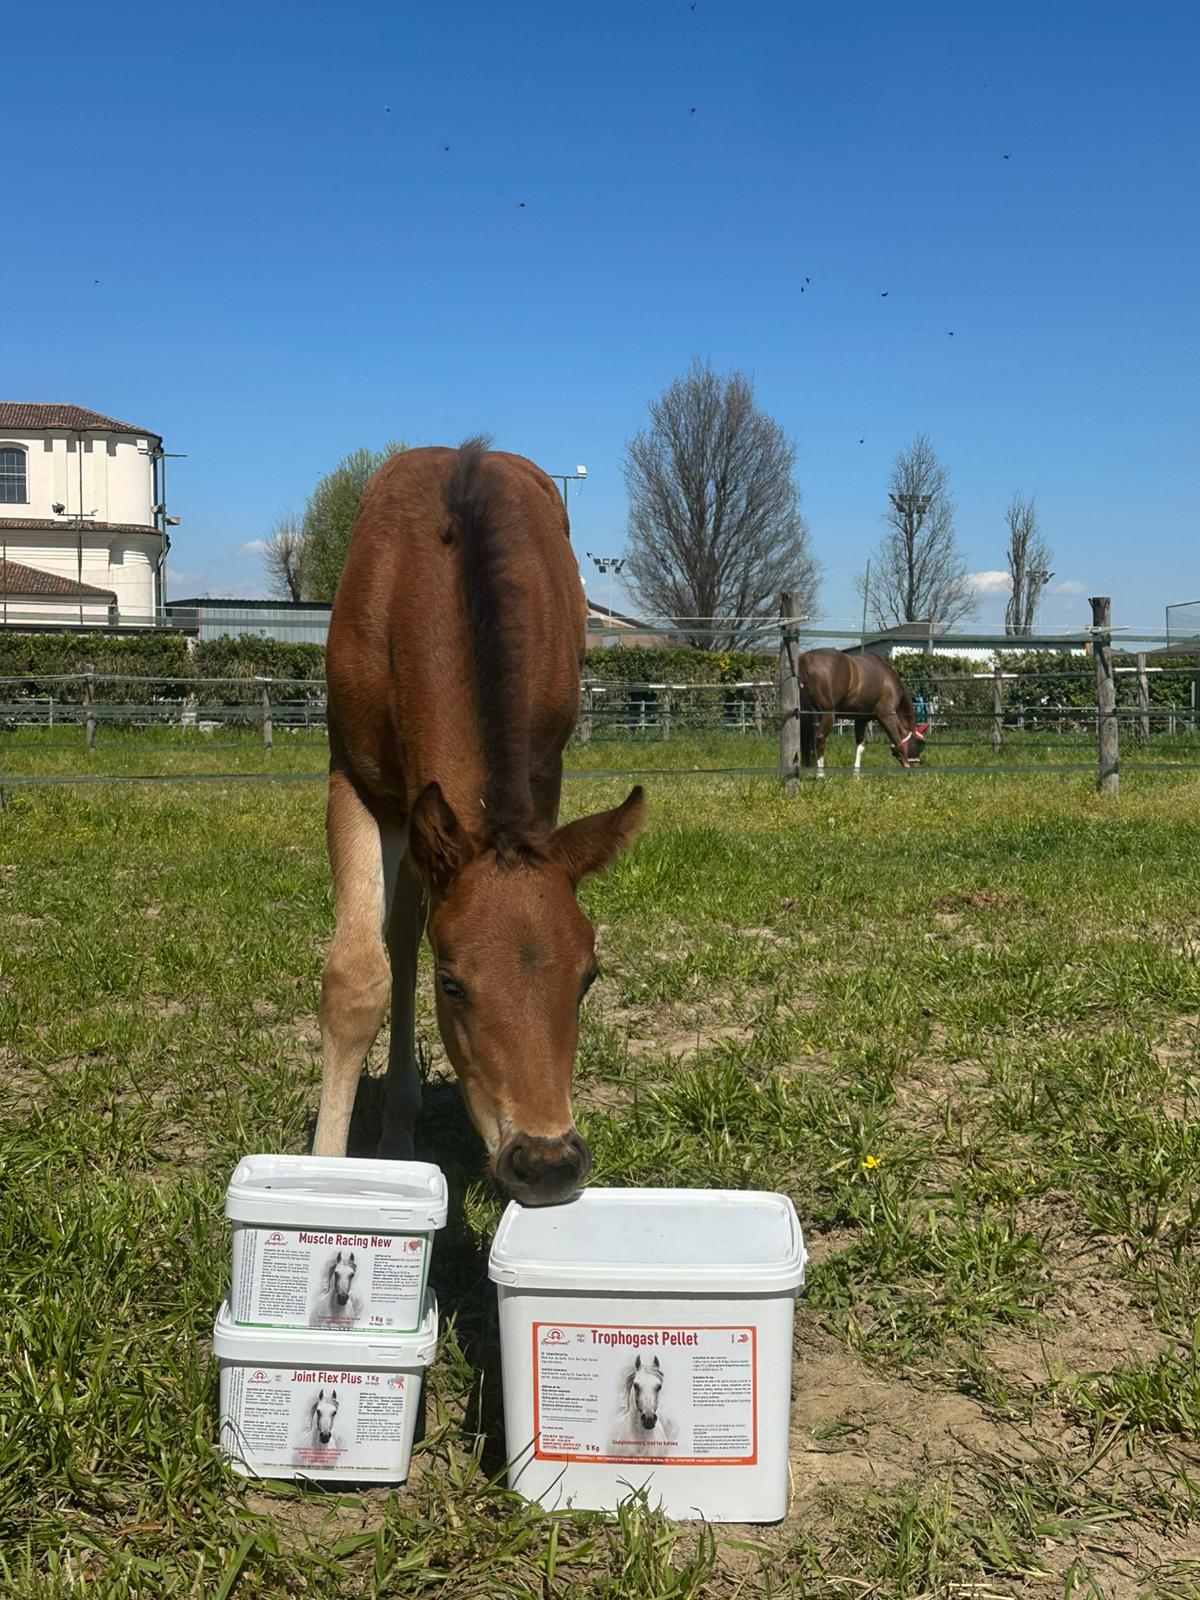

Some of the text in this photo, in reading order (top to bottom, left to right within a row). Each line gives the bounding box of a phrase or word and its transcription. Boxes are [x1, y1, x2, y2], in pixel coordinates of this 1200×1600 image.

[299, 1232, 335, 1246] Muscle
[336, 1234, 369, 1249] Racing
[371, 1236, 392, 1248] New
[591, 1329, 660, 1348] Trophogast
[662, 1331, 699, 1346] Pellet
[291, 1370, 316, 1383] Joint
[318, 1371, 338, 1384] Flex
[341, 1372, 362, 1384] Plus
